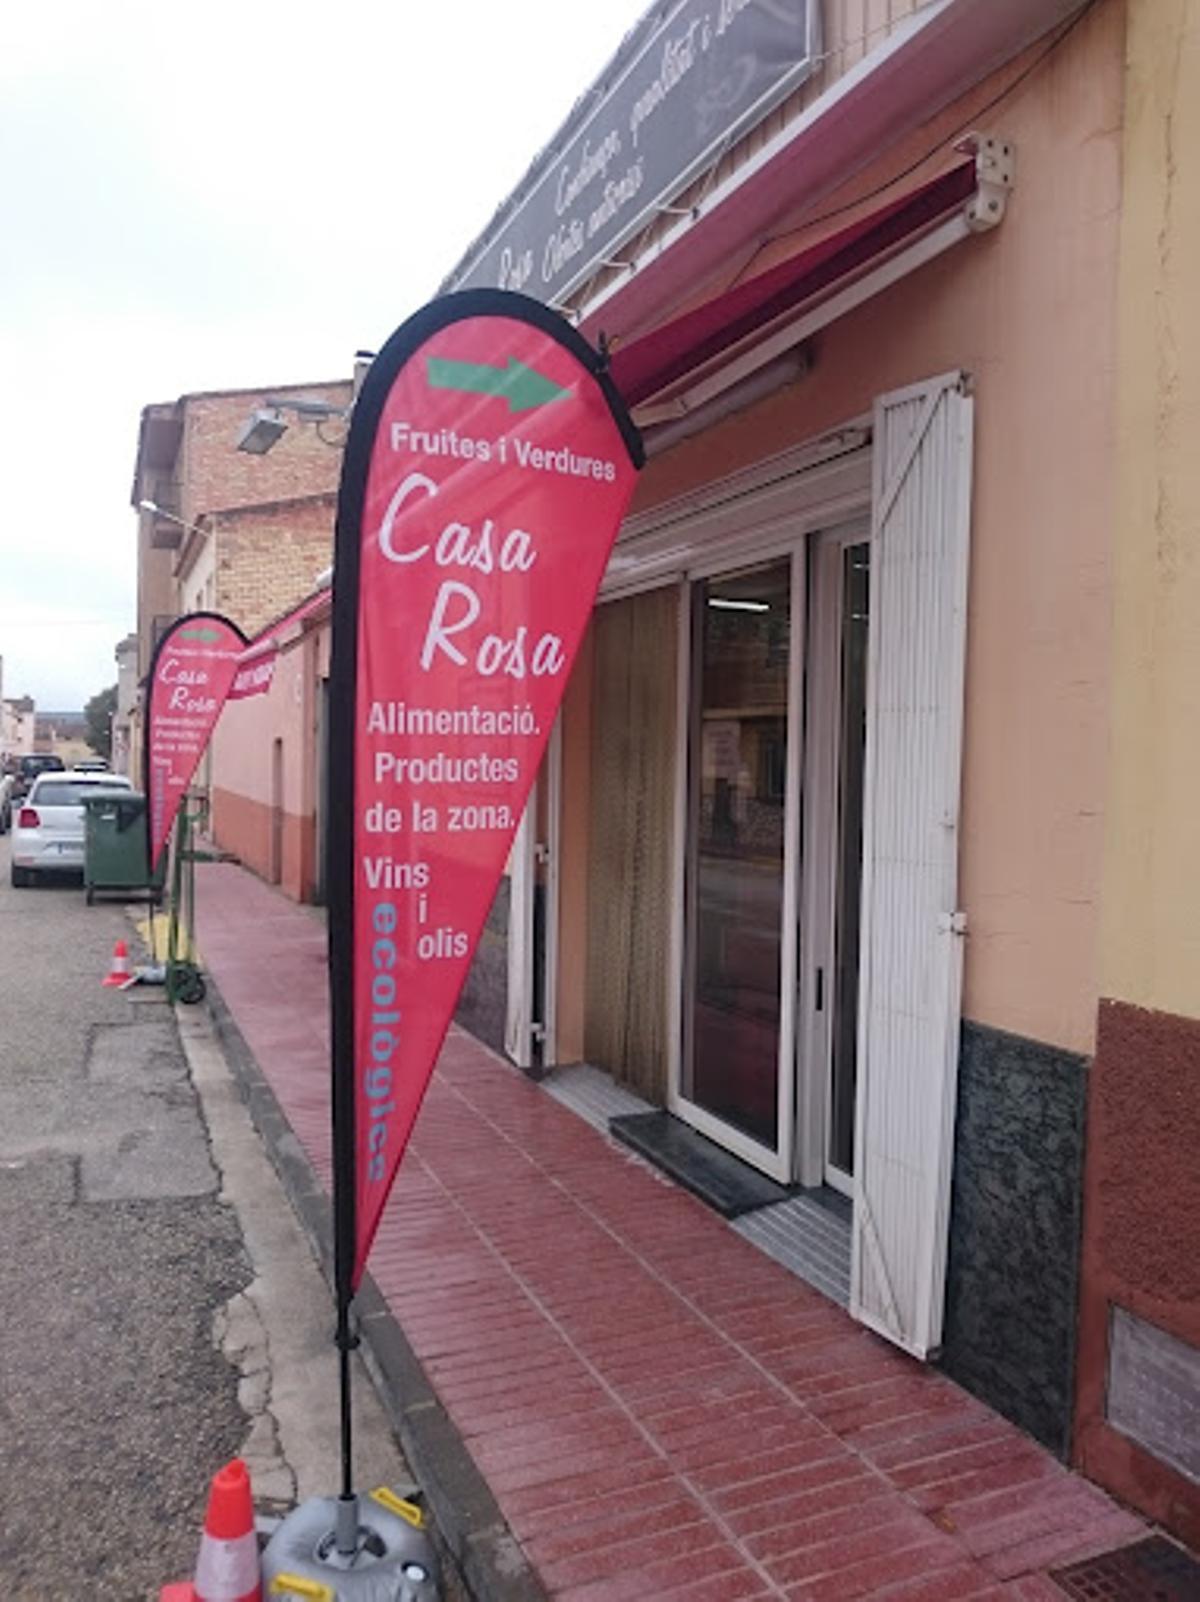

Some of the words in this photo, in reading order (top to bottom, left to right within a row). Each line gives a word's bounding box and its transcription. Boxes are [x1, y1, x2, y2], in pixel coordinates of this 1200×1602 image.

[391, 421, 491, 462] Fruites
[499, 437, 507, 465] i
[514, 438, 617, 482] Verdures
[378, 472, 537, 575] Casa
[420, 579, 566, 680] Rosa
[366, 701, 541, 736] Alimentació.
[374, 752, 519, 784] Productes
[365, 802, 402, 833] de
[412, 801, 438, 833] la
[447, 805, 516, 831] zona.
[363, 856, 431, 890] Vins
[417, 892, 428, 925] i
[416, 927, 470, 961] olis
